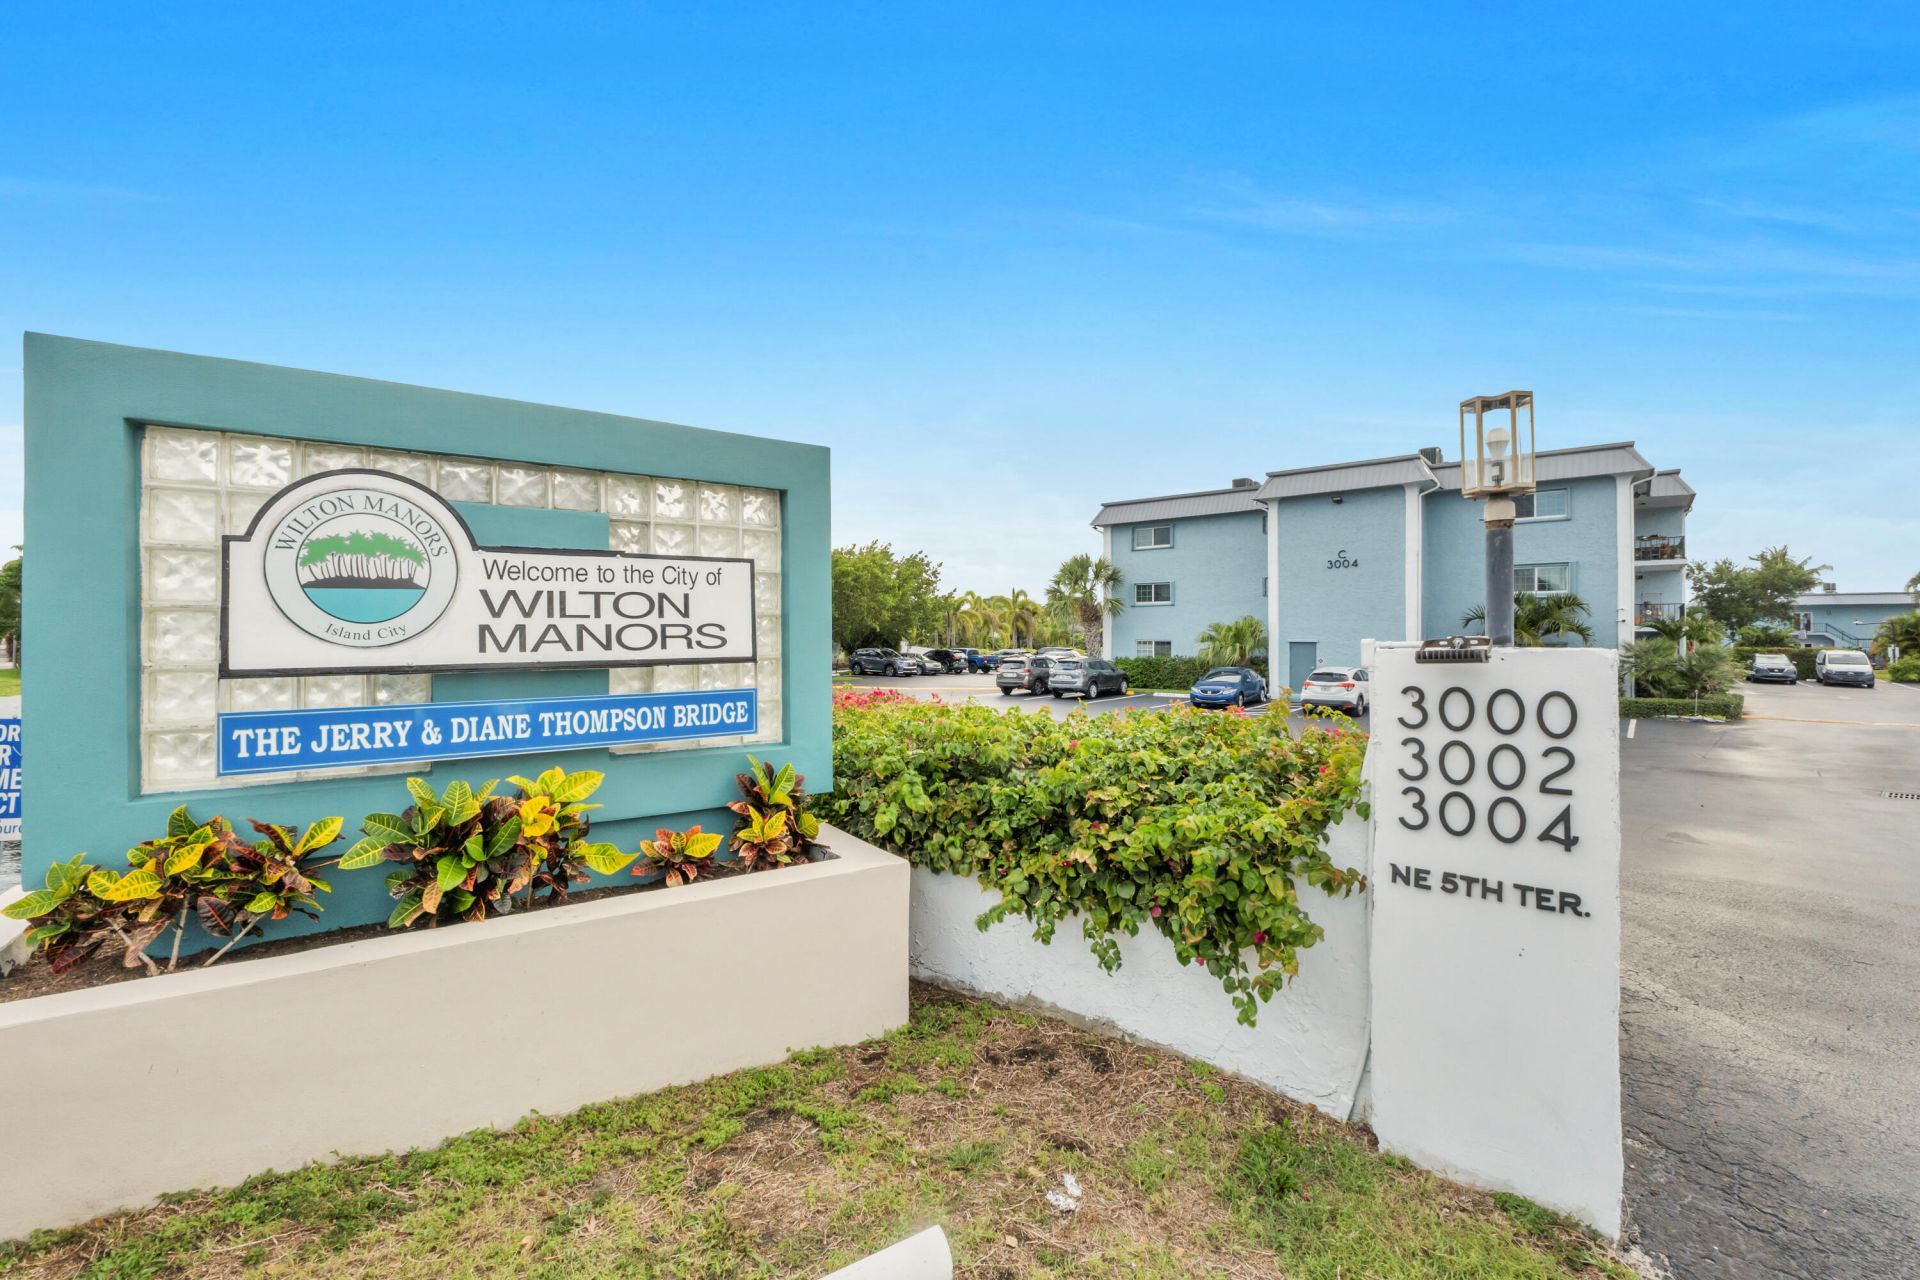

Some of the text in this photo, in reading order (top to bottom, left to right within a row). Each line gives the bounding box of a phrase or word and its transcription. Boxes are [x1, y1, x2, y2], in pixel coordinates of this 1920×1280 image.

[275, 495, 448, 557] WILTON MANORS
[482, 558, 723, 590] Welcome to the City of
[1327, 559, 1359, 570] 3004
[479, 589, 690, 619] WILTON
[324, 623, 407, 641] Island City
[478, 623, 728, 653] MANORS
[232, 701, 749, 758] THE JERRY & DIANE THOMPSON BRIDGE
[1397, 685, 1578, 739] 3000
[1397, 737, 1576, 796] 3002
[1398, 786, 1580, 852] 3004
[1389, 862, 1591, 918] NE 5TH TER.
